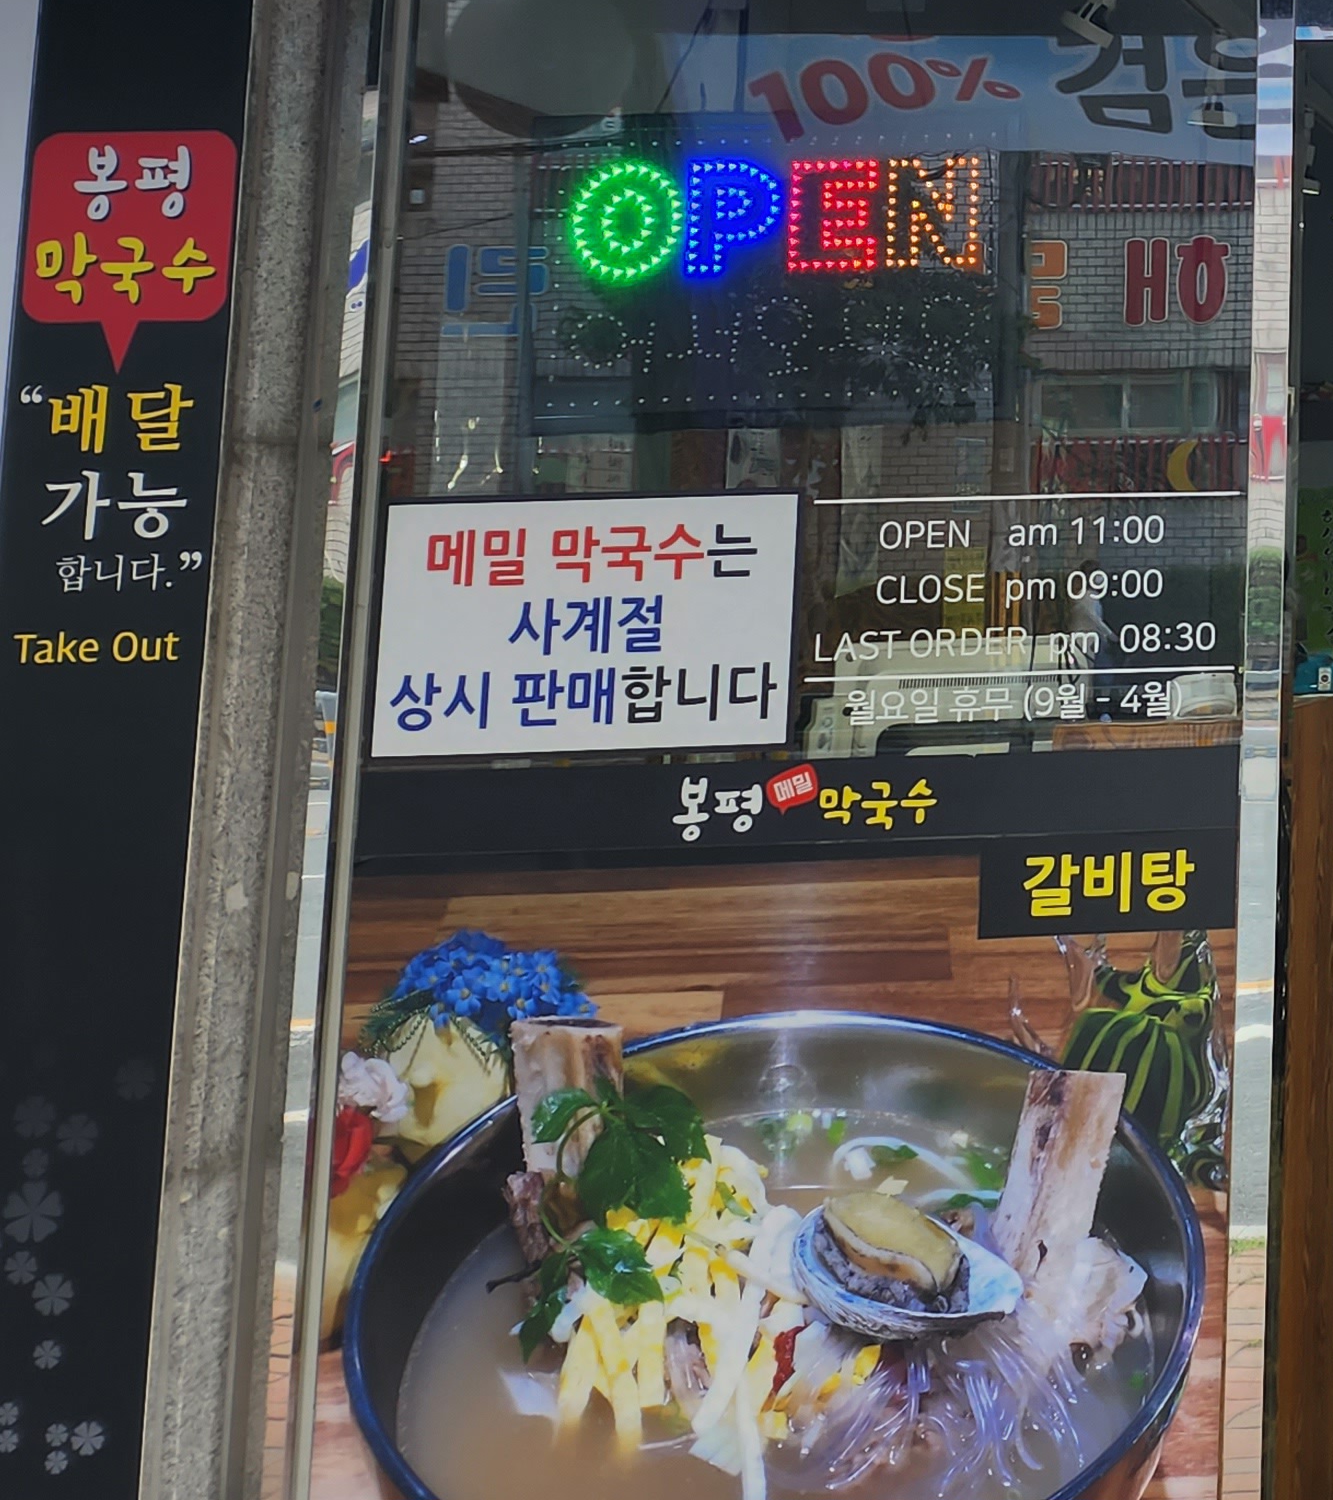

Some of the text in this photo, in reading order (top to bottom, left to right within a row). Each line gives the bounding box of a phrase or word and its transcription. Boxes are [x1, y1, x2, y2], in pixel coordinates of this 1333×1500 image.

[73, 145, 193, 220] 봉평
[571, 156, 982, 281] OPEN
[35, 232, 217, 304] 막국수
[41, 470, 188, 541] 가능
[879, 514, 1166, 550] OPEN am 11:00
[426, 523, 758, 587] 메밀 막국수는
[876, 568, 1164, 609] CLOSE pm 09:00
[13, 630, 180, 666] Take Out
[508, 594, 664, 656] 사계절
[813, 621, 1217, 663] LAST ORDER pm 08:30
[389, 661, 778, 732] 상시 판매합니다
[845, 687, 939, 726] 월요일
[949, 686, 1014, 723] 휴무
[1120, 679, 1183, 719] 4월)
[672, 775, 938, 842] 봉평 메밀 막국수
[1022, 848, 1196, 918] 갈비탕
